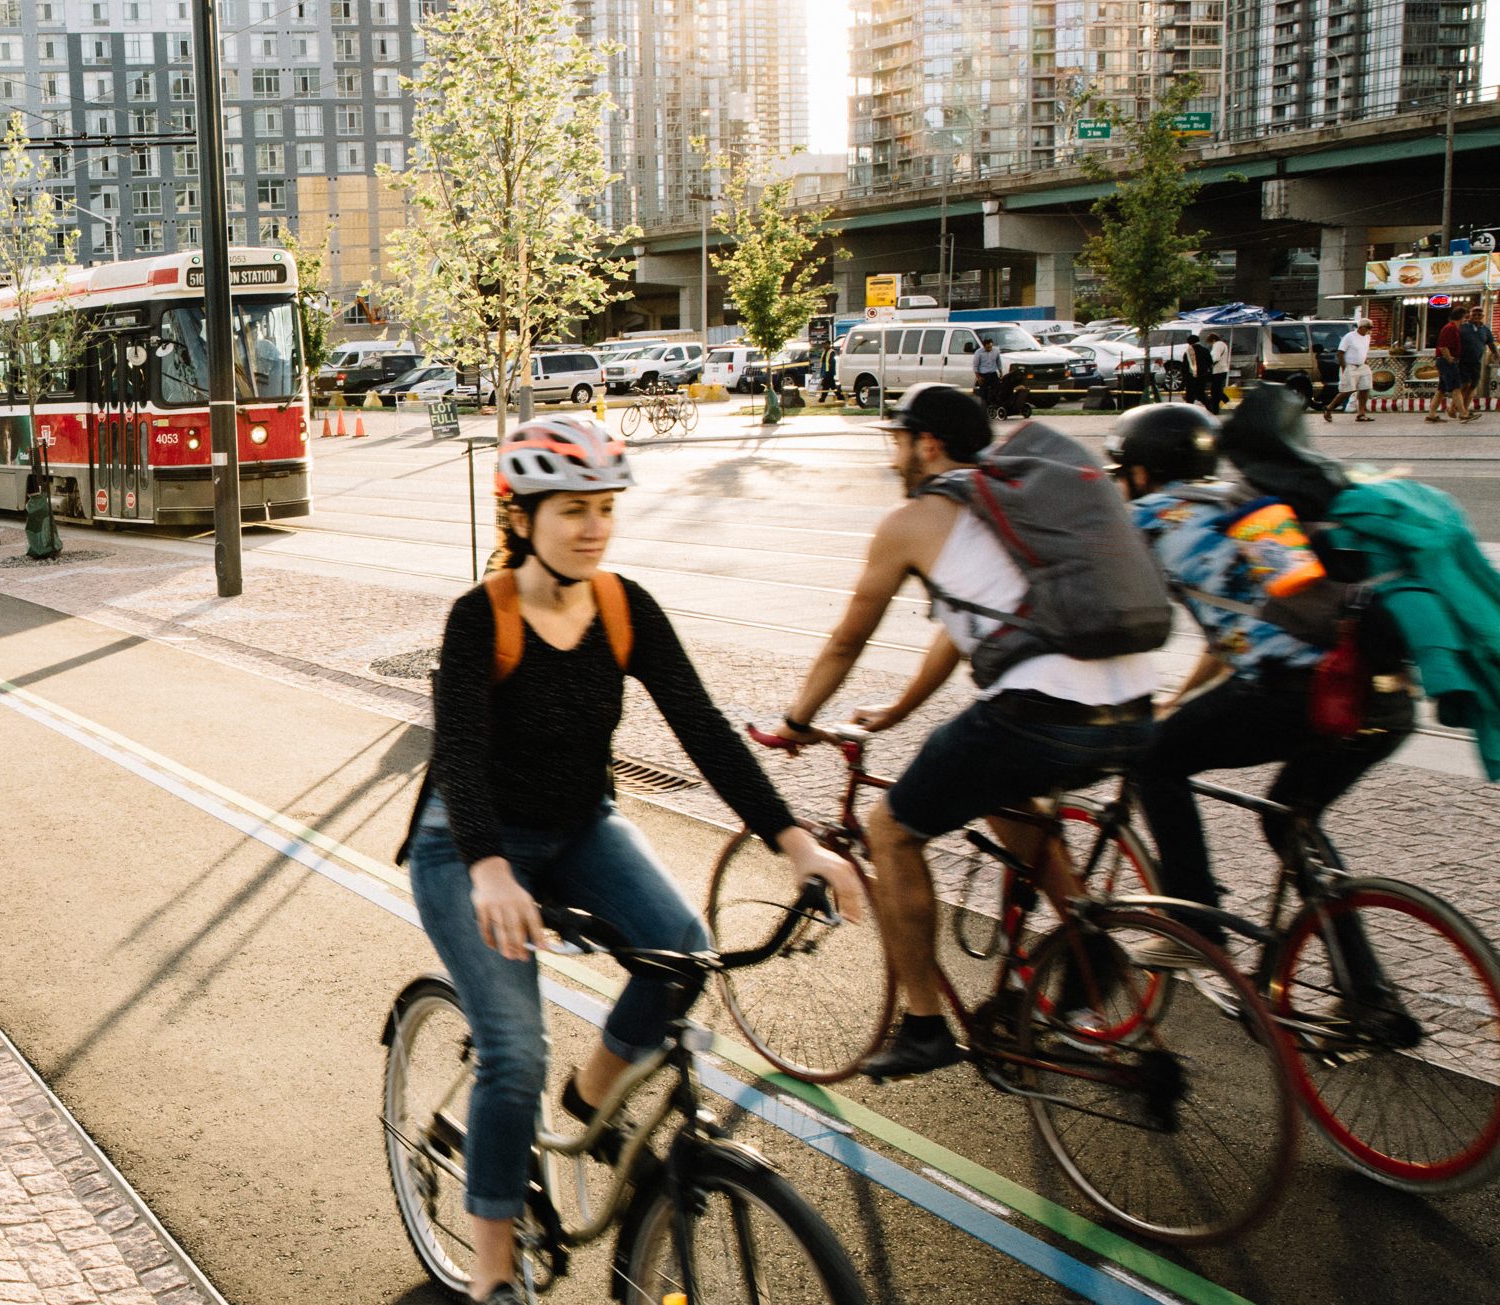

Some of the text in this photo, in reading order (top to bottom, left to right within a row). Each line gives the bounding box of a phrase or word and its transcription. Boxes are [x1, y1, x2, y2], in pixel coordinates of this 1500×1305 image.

[241, 270, 277, 283] STATION
[431, 402, 452, 414] LOT
[431, 413, 458, 425] FULL
[155, 433, 179, 444] 4053
